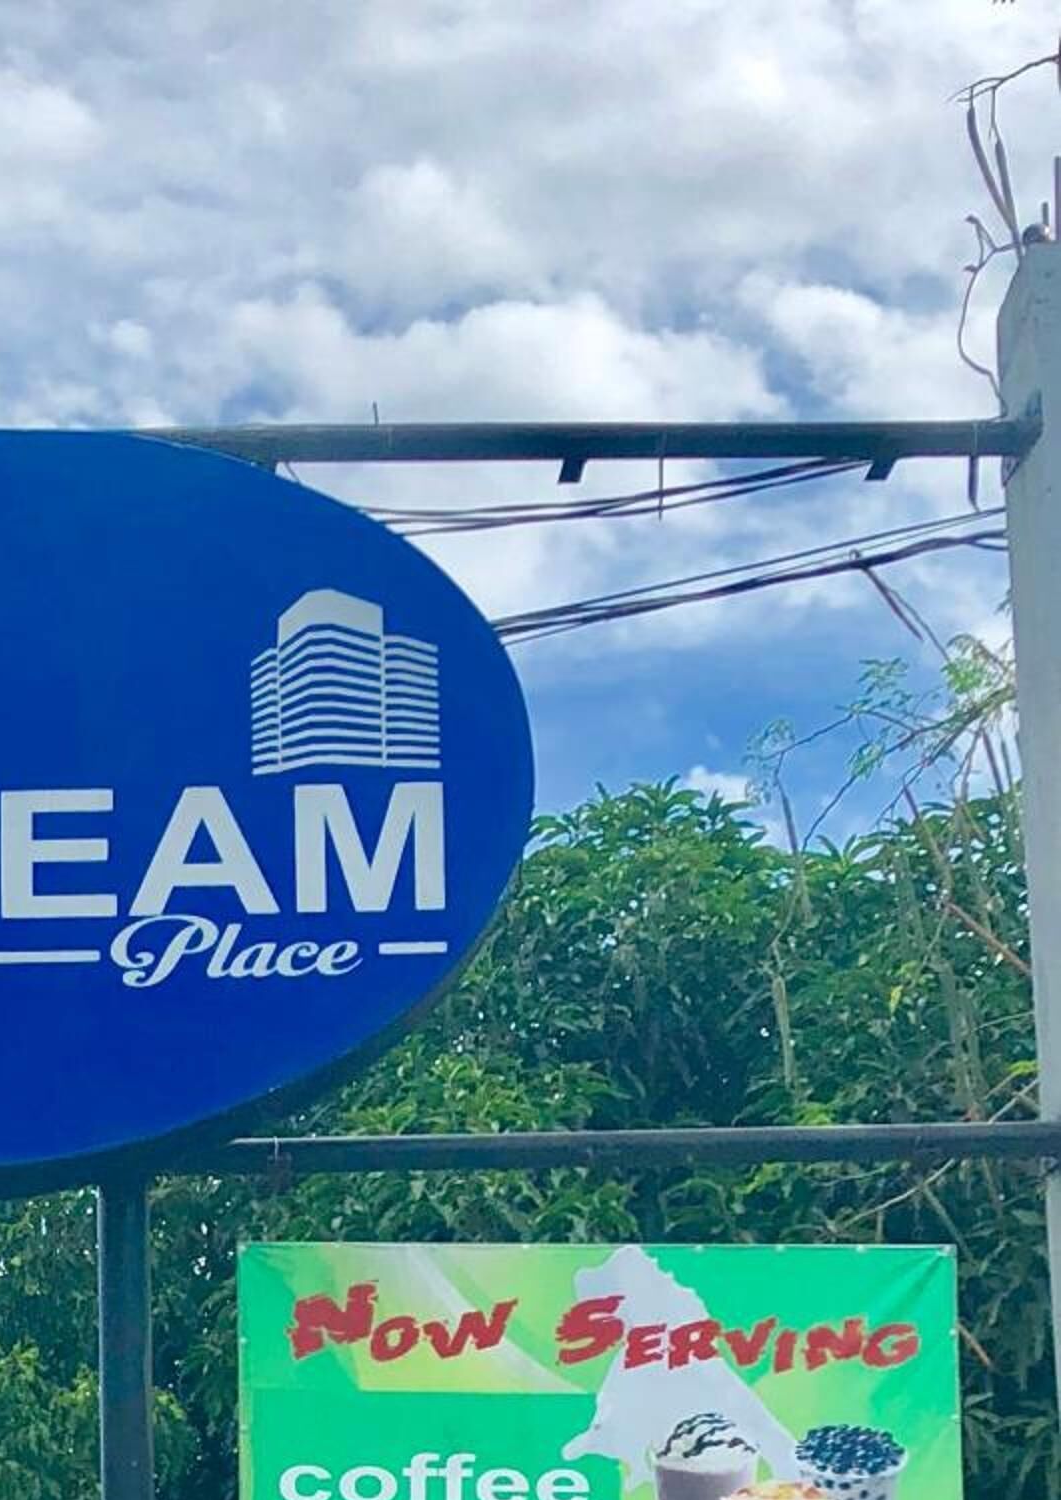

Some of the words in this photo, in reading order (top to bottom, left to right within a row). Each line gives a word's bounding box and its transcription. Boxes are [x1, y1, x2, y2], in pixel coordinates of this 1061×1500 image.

[110, 914, 362, 988] Place
[287, 1280, 519, 1361] NOW
[555, 1296, 922, 1373] SERVING
